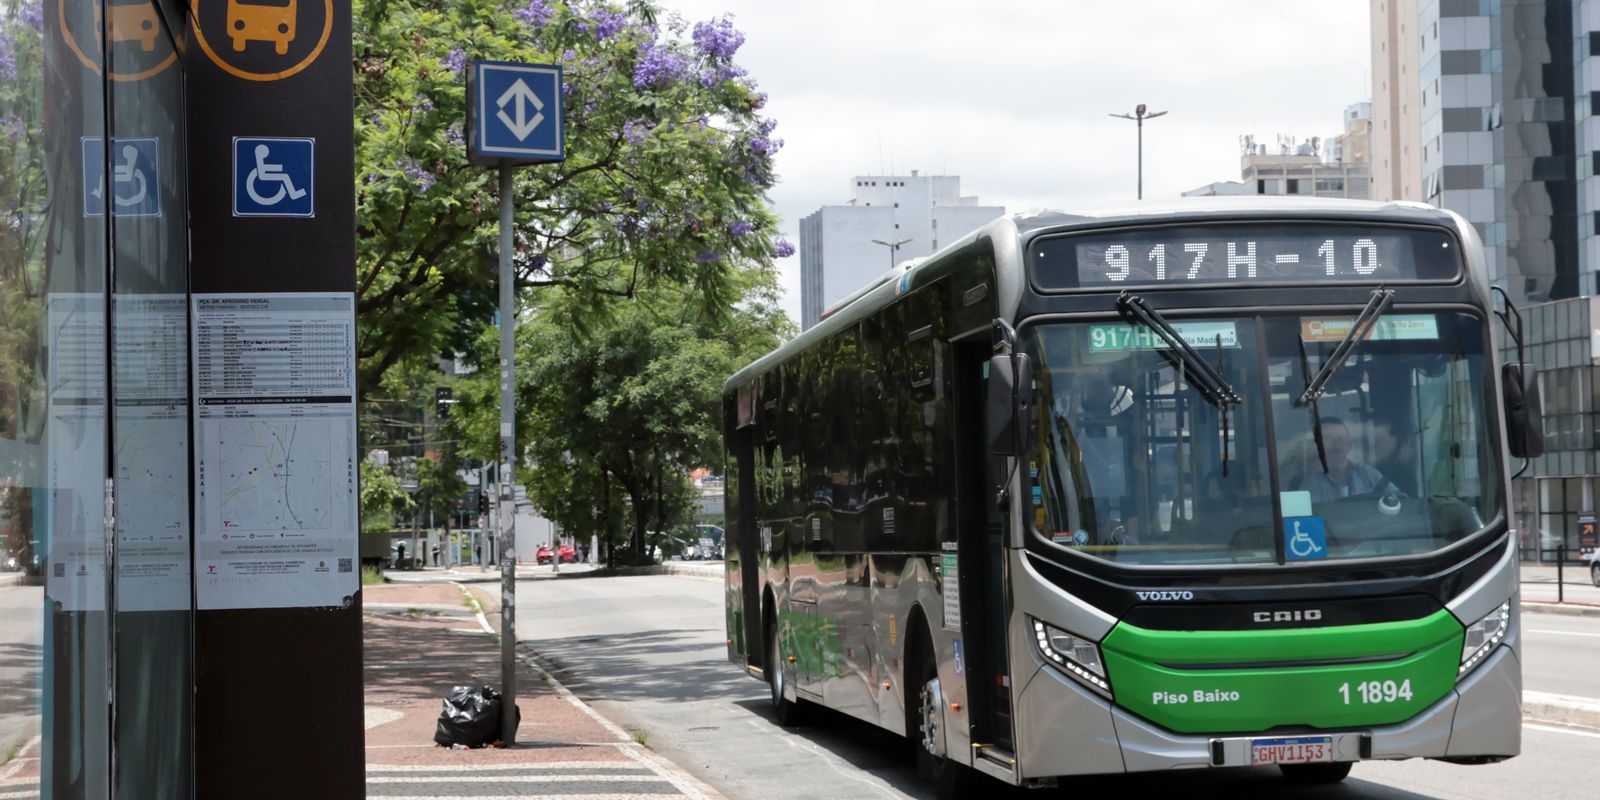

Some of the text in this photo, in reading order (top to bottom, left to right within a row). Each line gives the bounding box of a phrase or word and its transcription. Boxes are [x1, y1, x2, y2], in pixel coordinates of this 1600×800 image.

[1091, 323, 1150, 348] 917H
[1197, 335, 1234, 344] Madaena
[1136, 591, 1193, 601] VOLVO
[1253, 609, 1322, 622] CAIO
[1152, 689, 1240, 705] Piso Baixo
[1338, 679, 1413, 705] 1 1894
